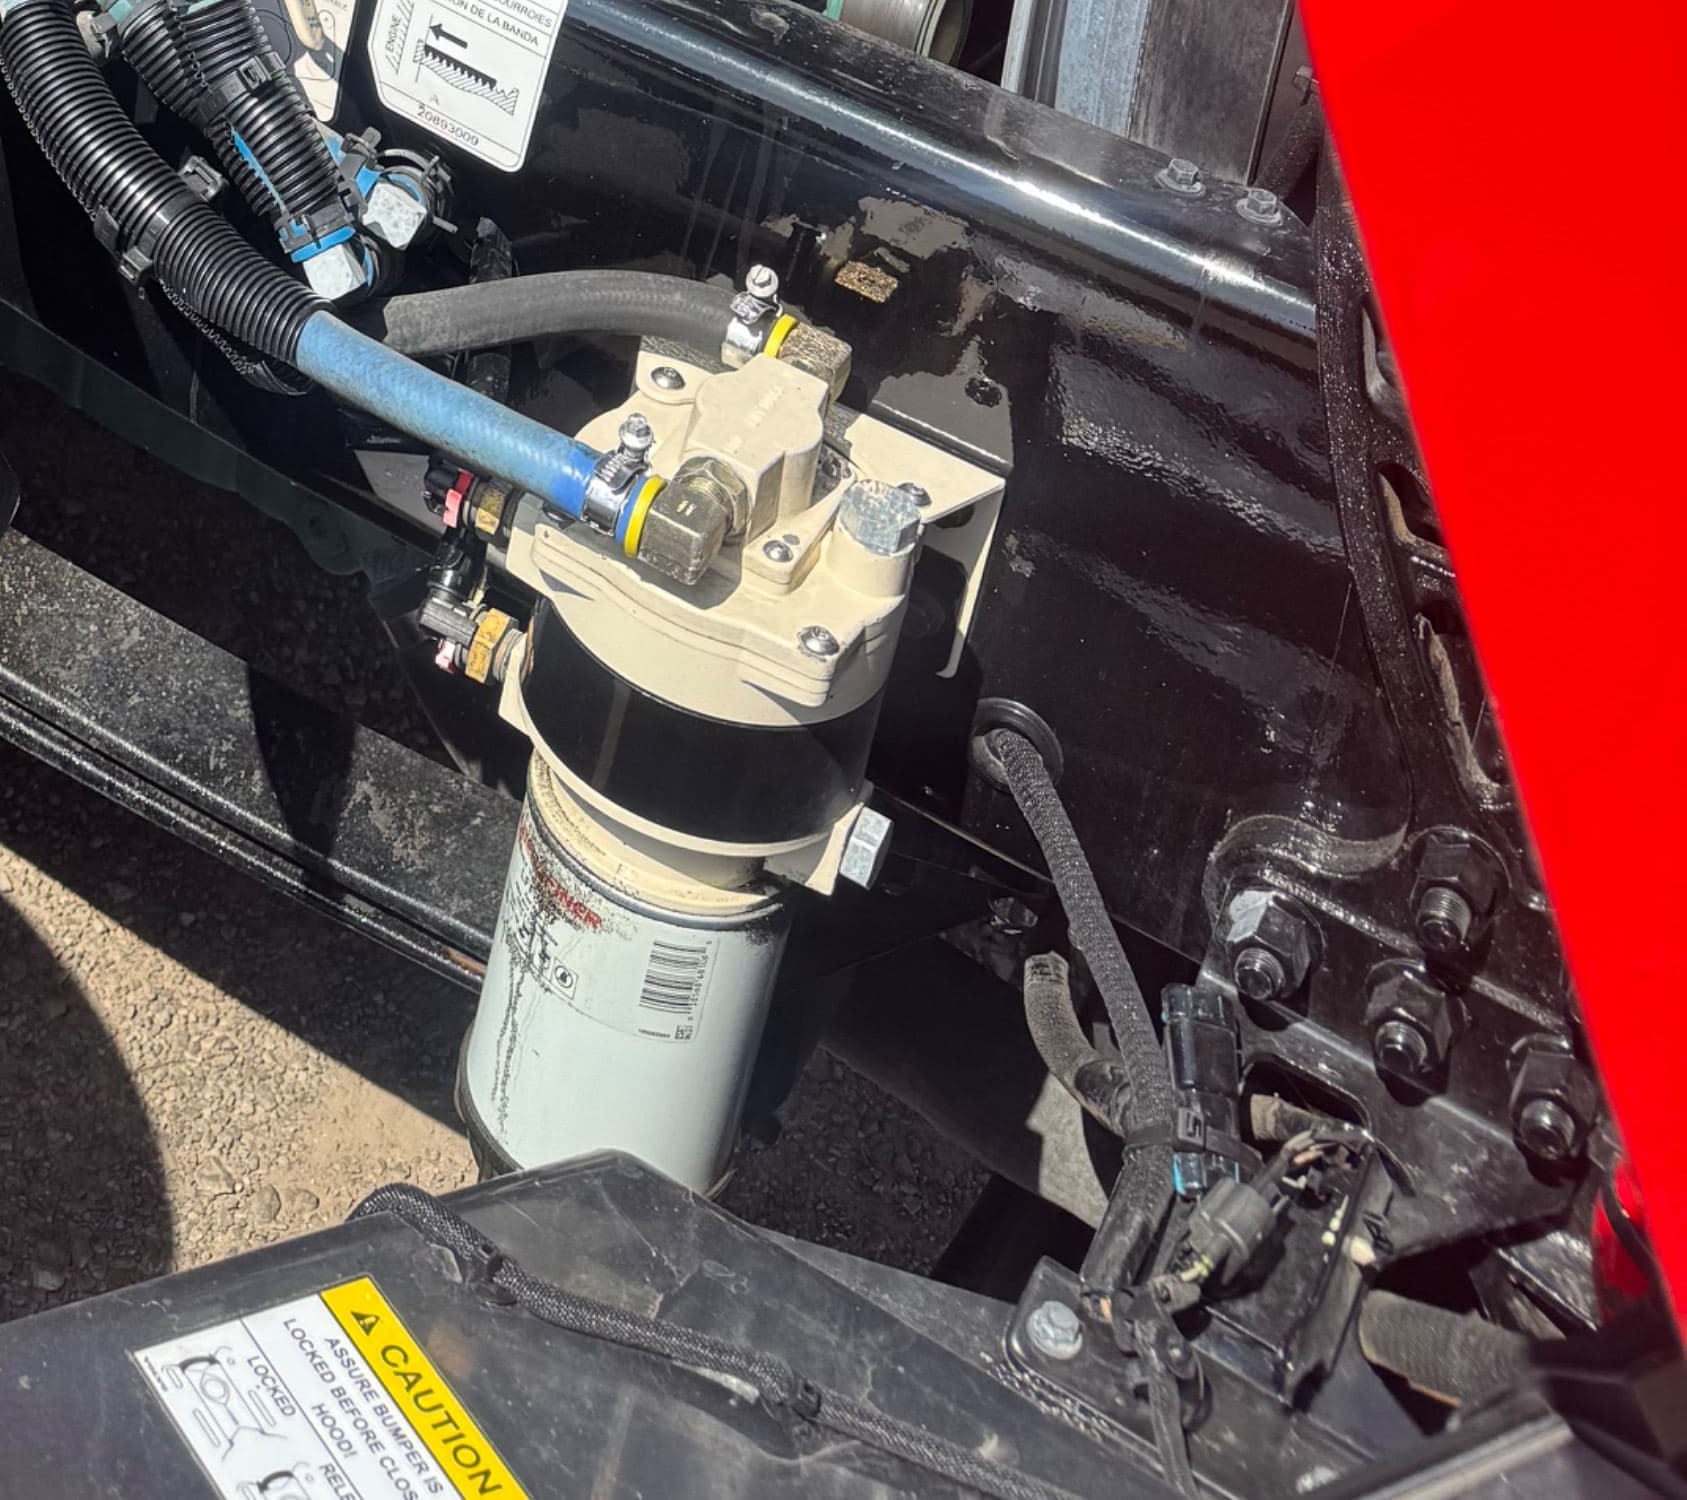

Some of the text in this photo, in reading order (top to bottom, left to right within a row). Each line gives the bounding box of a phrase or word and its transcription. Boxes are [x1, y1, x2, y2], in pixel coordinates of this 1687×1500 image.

[385, 13, 402, 53] ENGINE
[469, 2, 487, 20] DE
[486, 11, 502, 28] LA
[501, 18, 540, 47] BANDA
[417, 105, 480, 148] 20893009
[246, 1355, 297, 1417] LOCKED
[283, 1318, 336, 1384] LOCKED
[330, 1384, 386, 1455] BEFORE
[324, 1336, 444, 1494] ASSURE BUMPER IS
[312, 1402, 358, 1460] HOOD!
[380, 1344, 503, 1496] CAUTION
